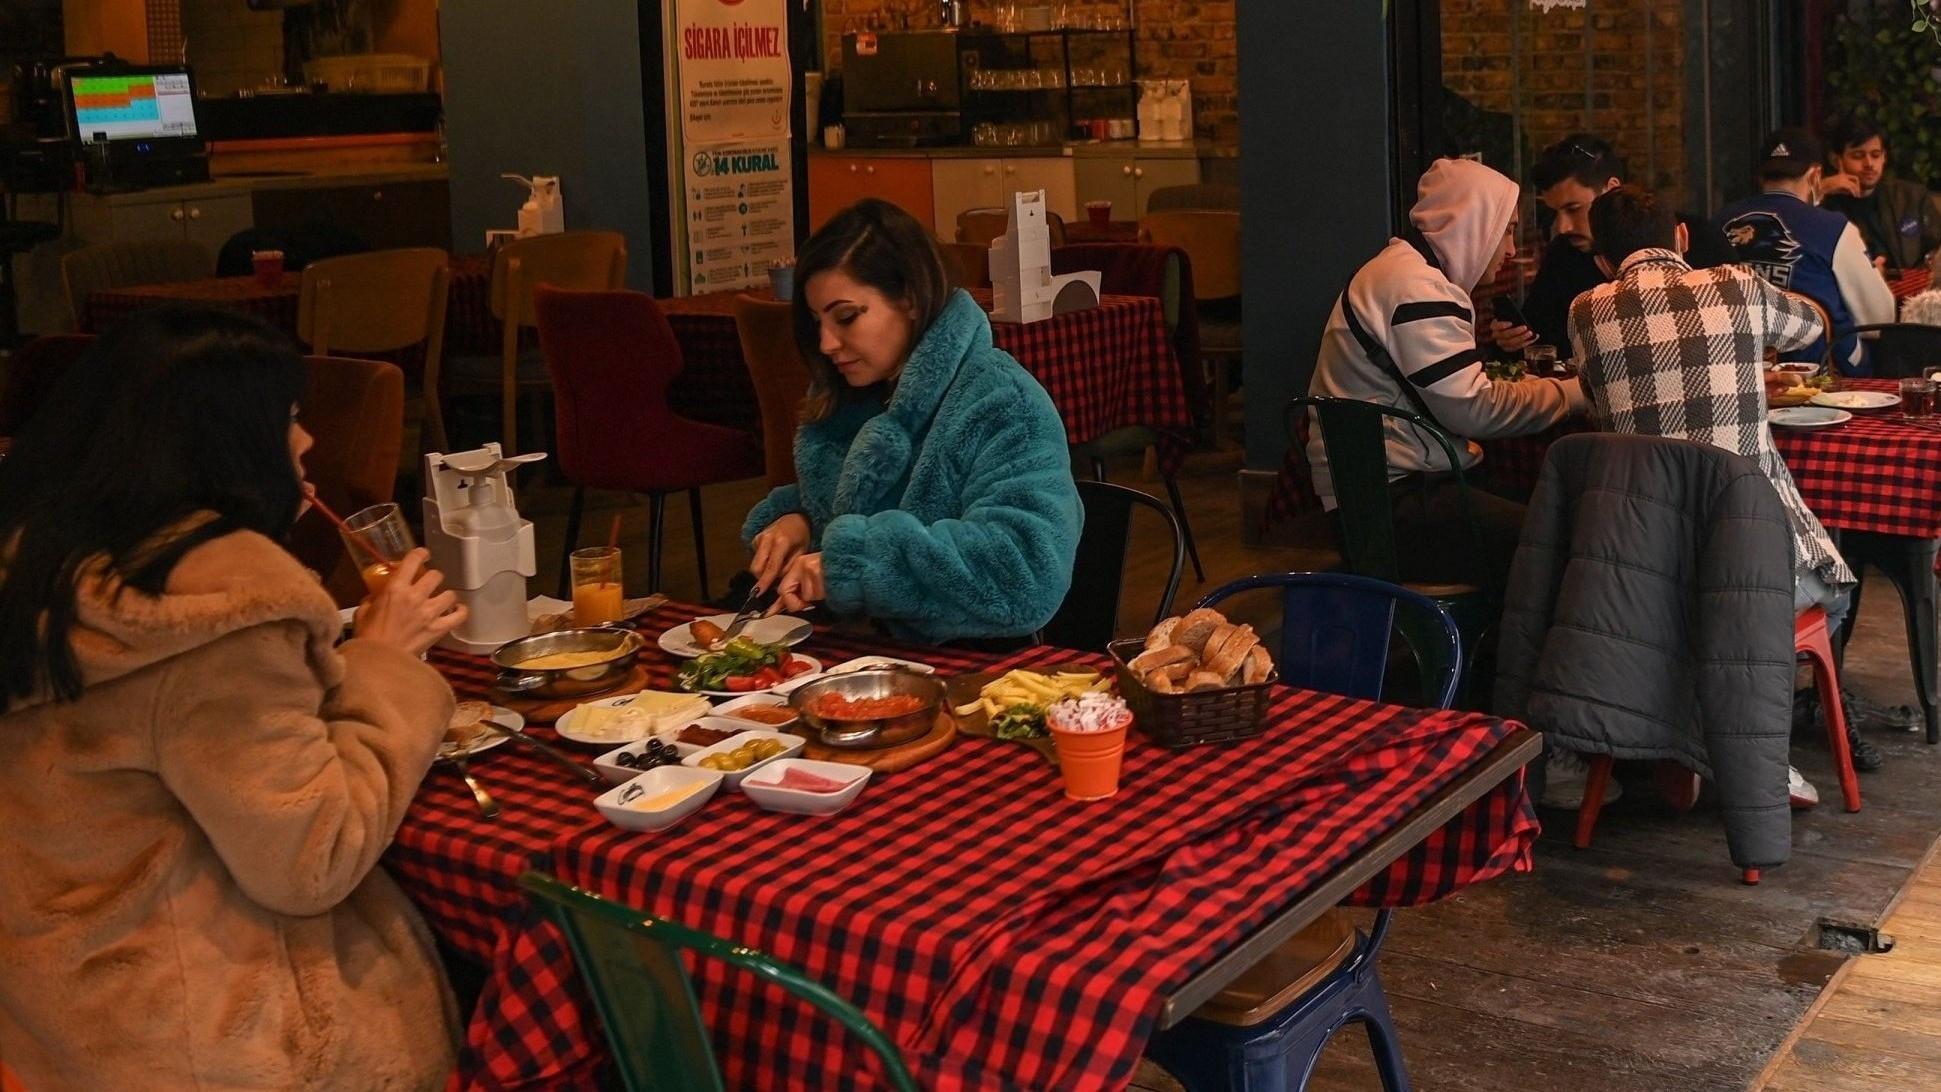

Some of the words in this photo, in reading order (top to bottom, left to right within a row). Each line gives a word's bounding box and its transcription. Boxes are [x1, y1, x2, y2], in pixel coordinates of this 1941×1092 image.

[684, 22, 731, 60] SİGARA
[733, 22, 781, 63] İÇİLMEZ
[712, 155, 729, 176] 14
[732, 153, 779, 174] KURAL
